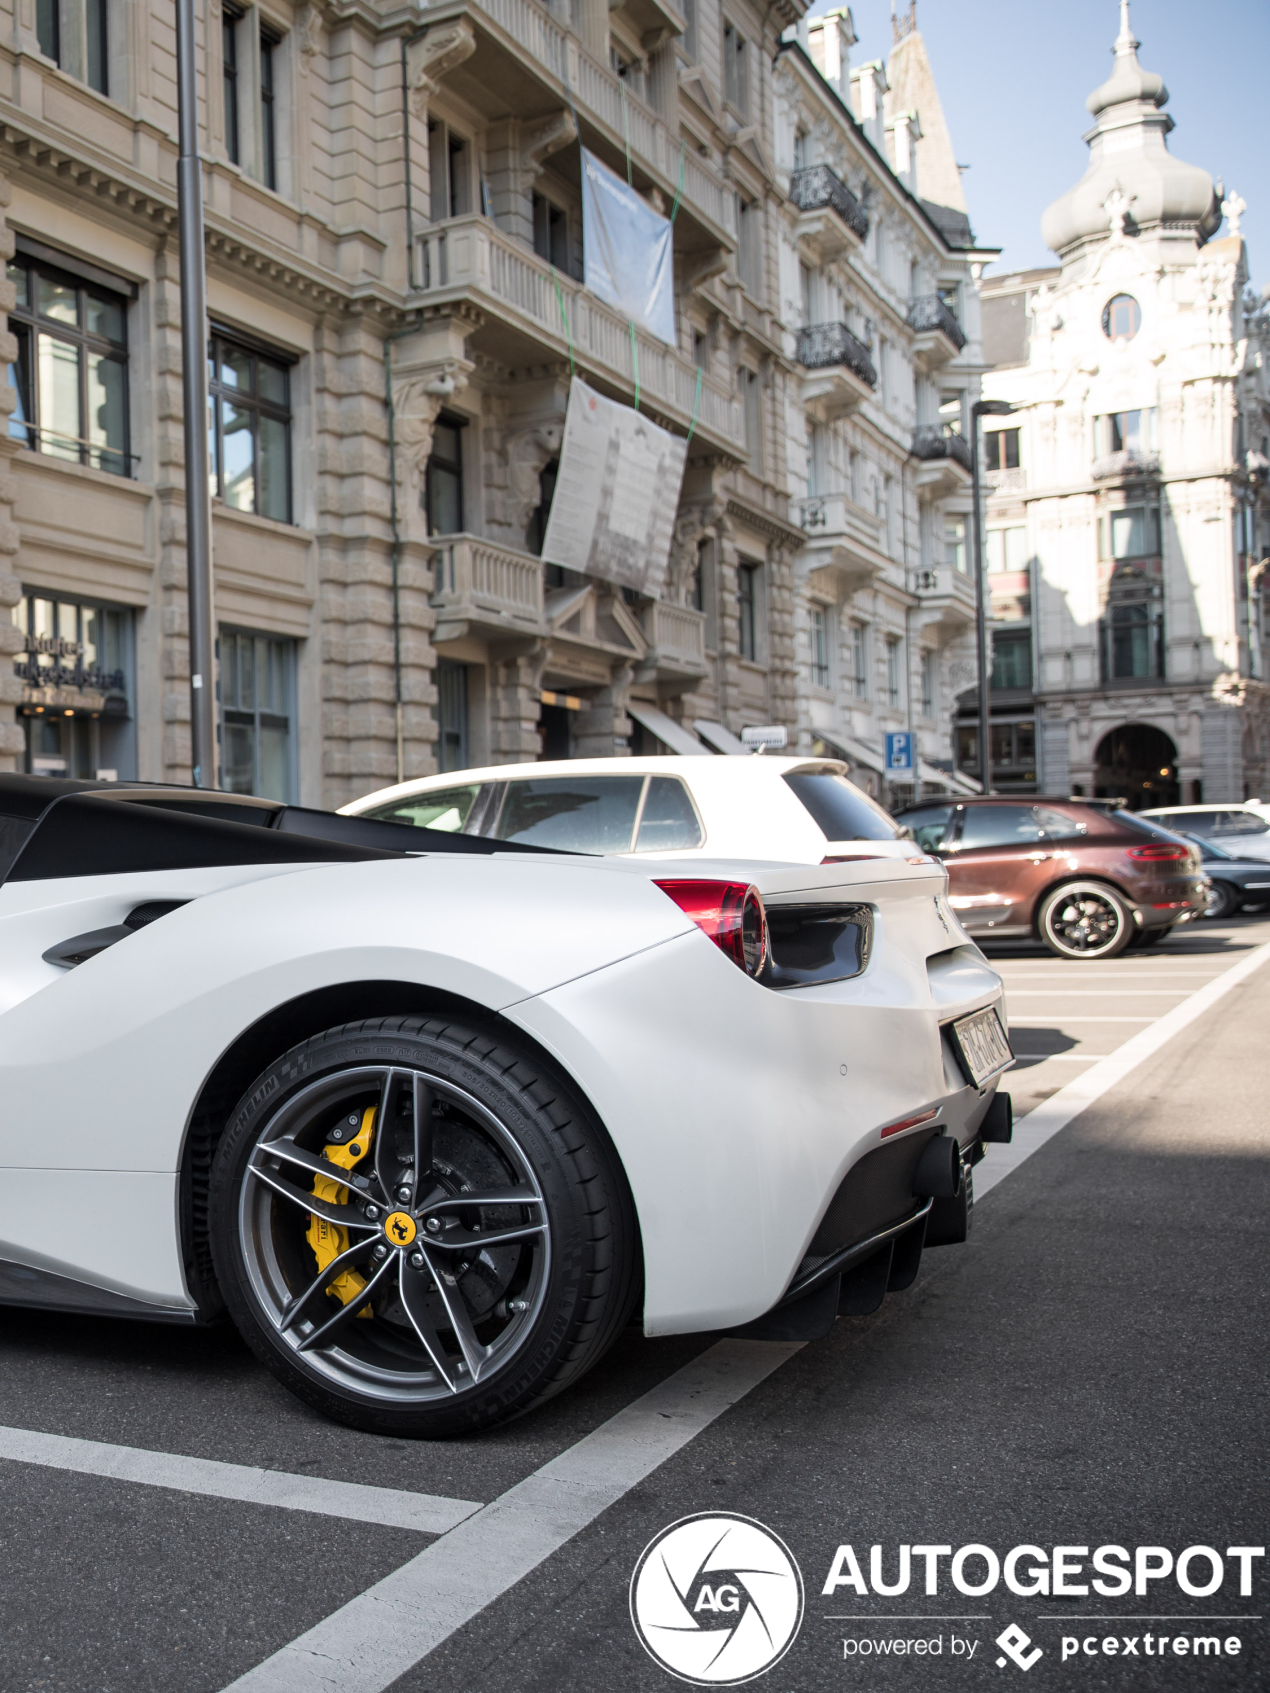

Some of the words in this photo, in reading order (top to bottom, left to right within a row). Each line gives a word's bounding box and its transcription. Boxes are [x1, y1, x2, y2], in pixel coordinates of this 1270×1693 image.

[892, 735, 906, 753] P
[223, 1075, 277, 1160] MICHELIN
[502, 1314, 570, 1404] MICHELIN
